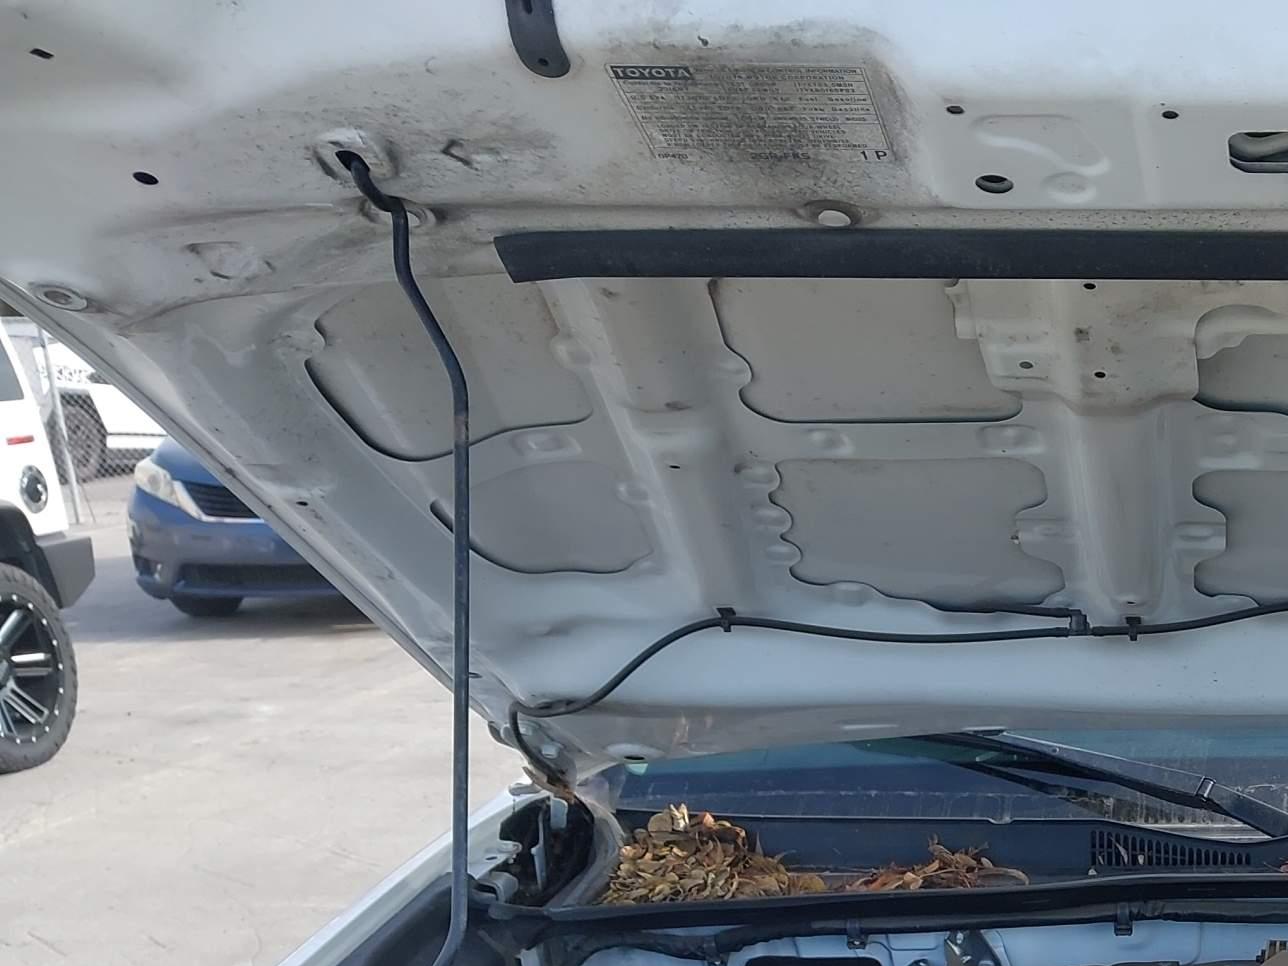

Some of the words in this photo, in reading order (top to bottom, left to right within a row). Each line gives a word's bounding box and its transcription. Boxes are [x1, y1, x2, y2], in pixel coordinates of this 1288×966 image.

[612, 68, 690, 77] TOYOTA
[860, 150, 869, 160] 1
[875, 150, 888, 160] P
